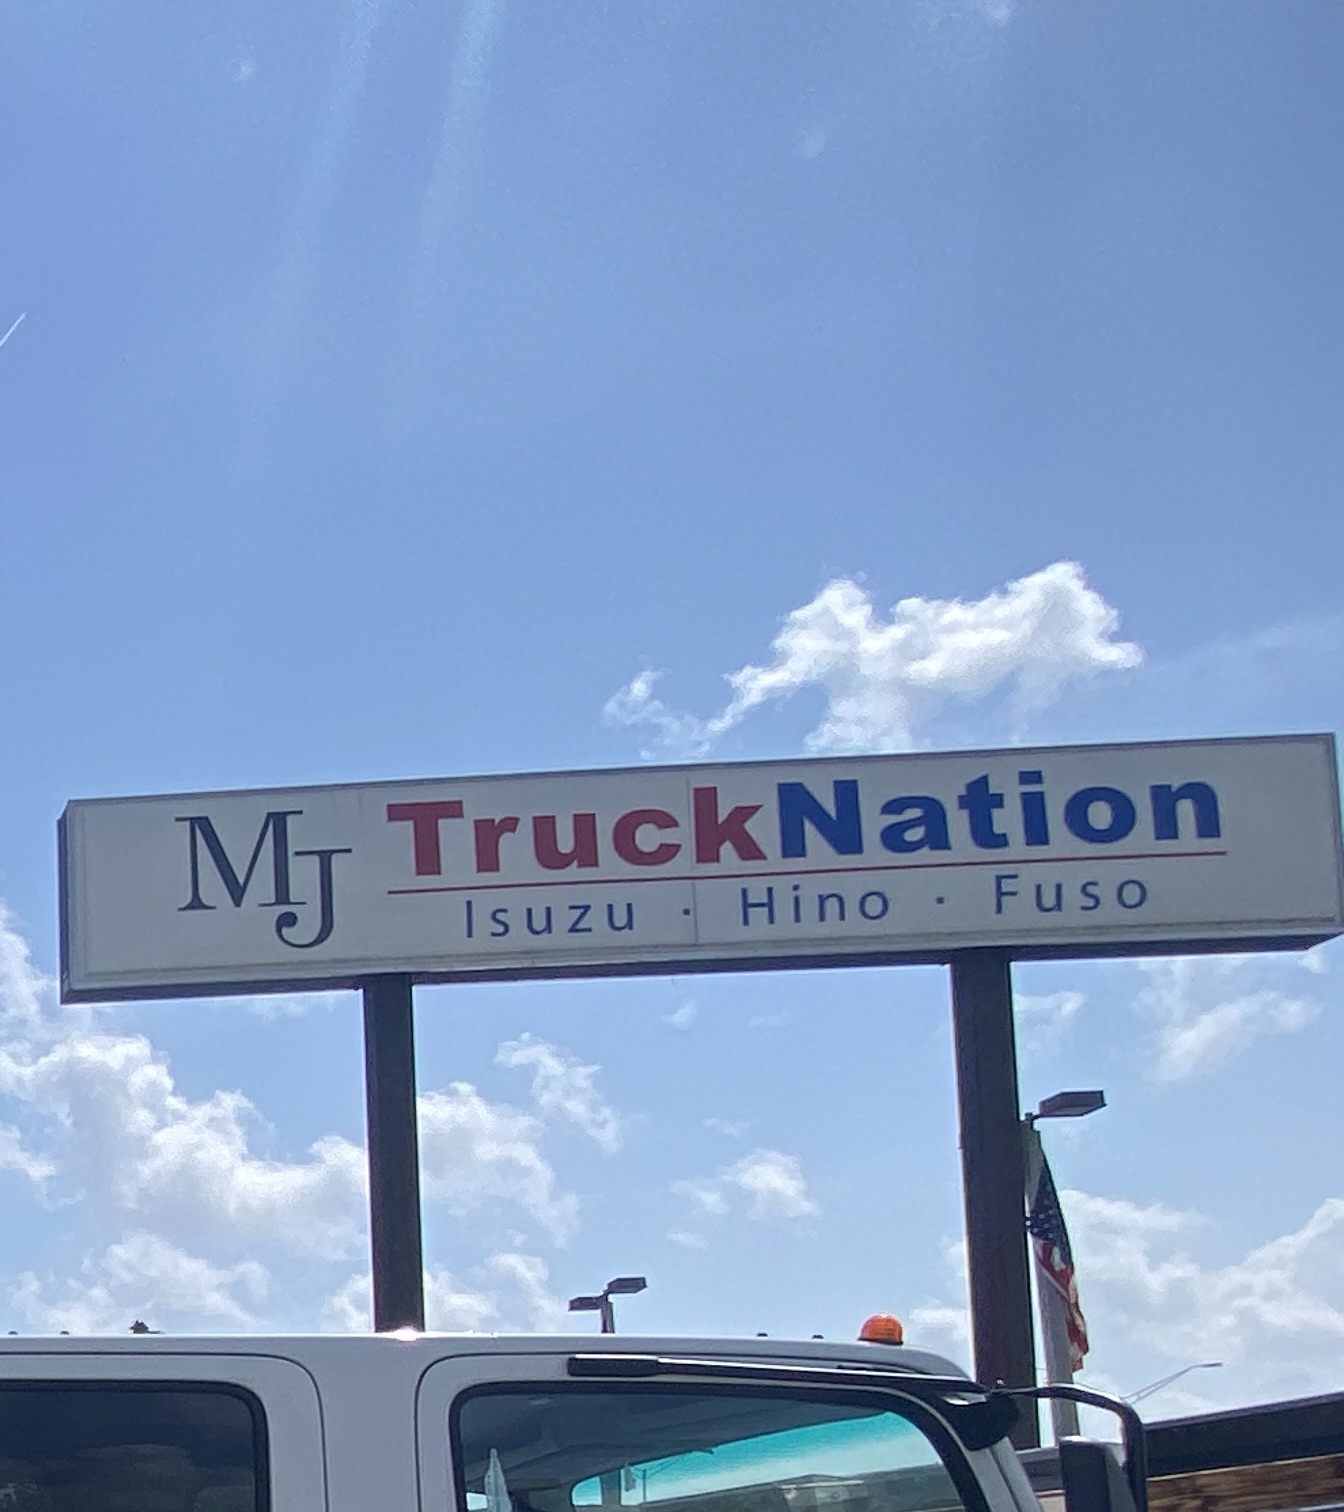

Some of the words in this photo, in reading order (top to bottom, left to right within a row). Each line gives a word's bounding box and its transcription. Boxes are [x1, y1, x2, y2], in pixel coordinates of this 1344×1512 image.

[386, 769, 1222, 876] TruckNation
[174, 809, 353, 949] MJ
[465, 899, 636, 939] Isuzu
[740, 884, 890, 927] Hino
[993, 873, 1148, 915] Fuso
